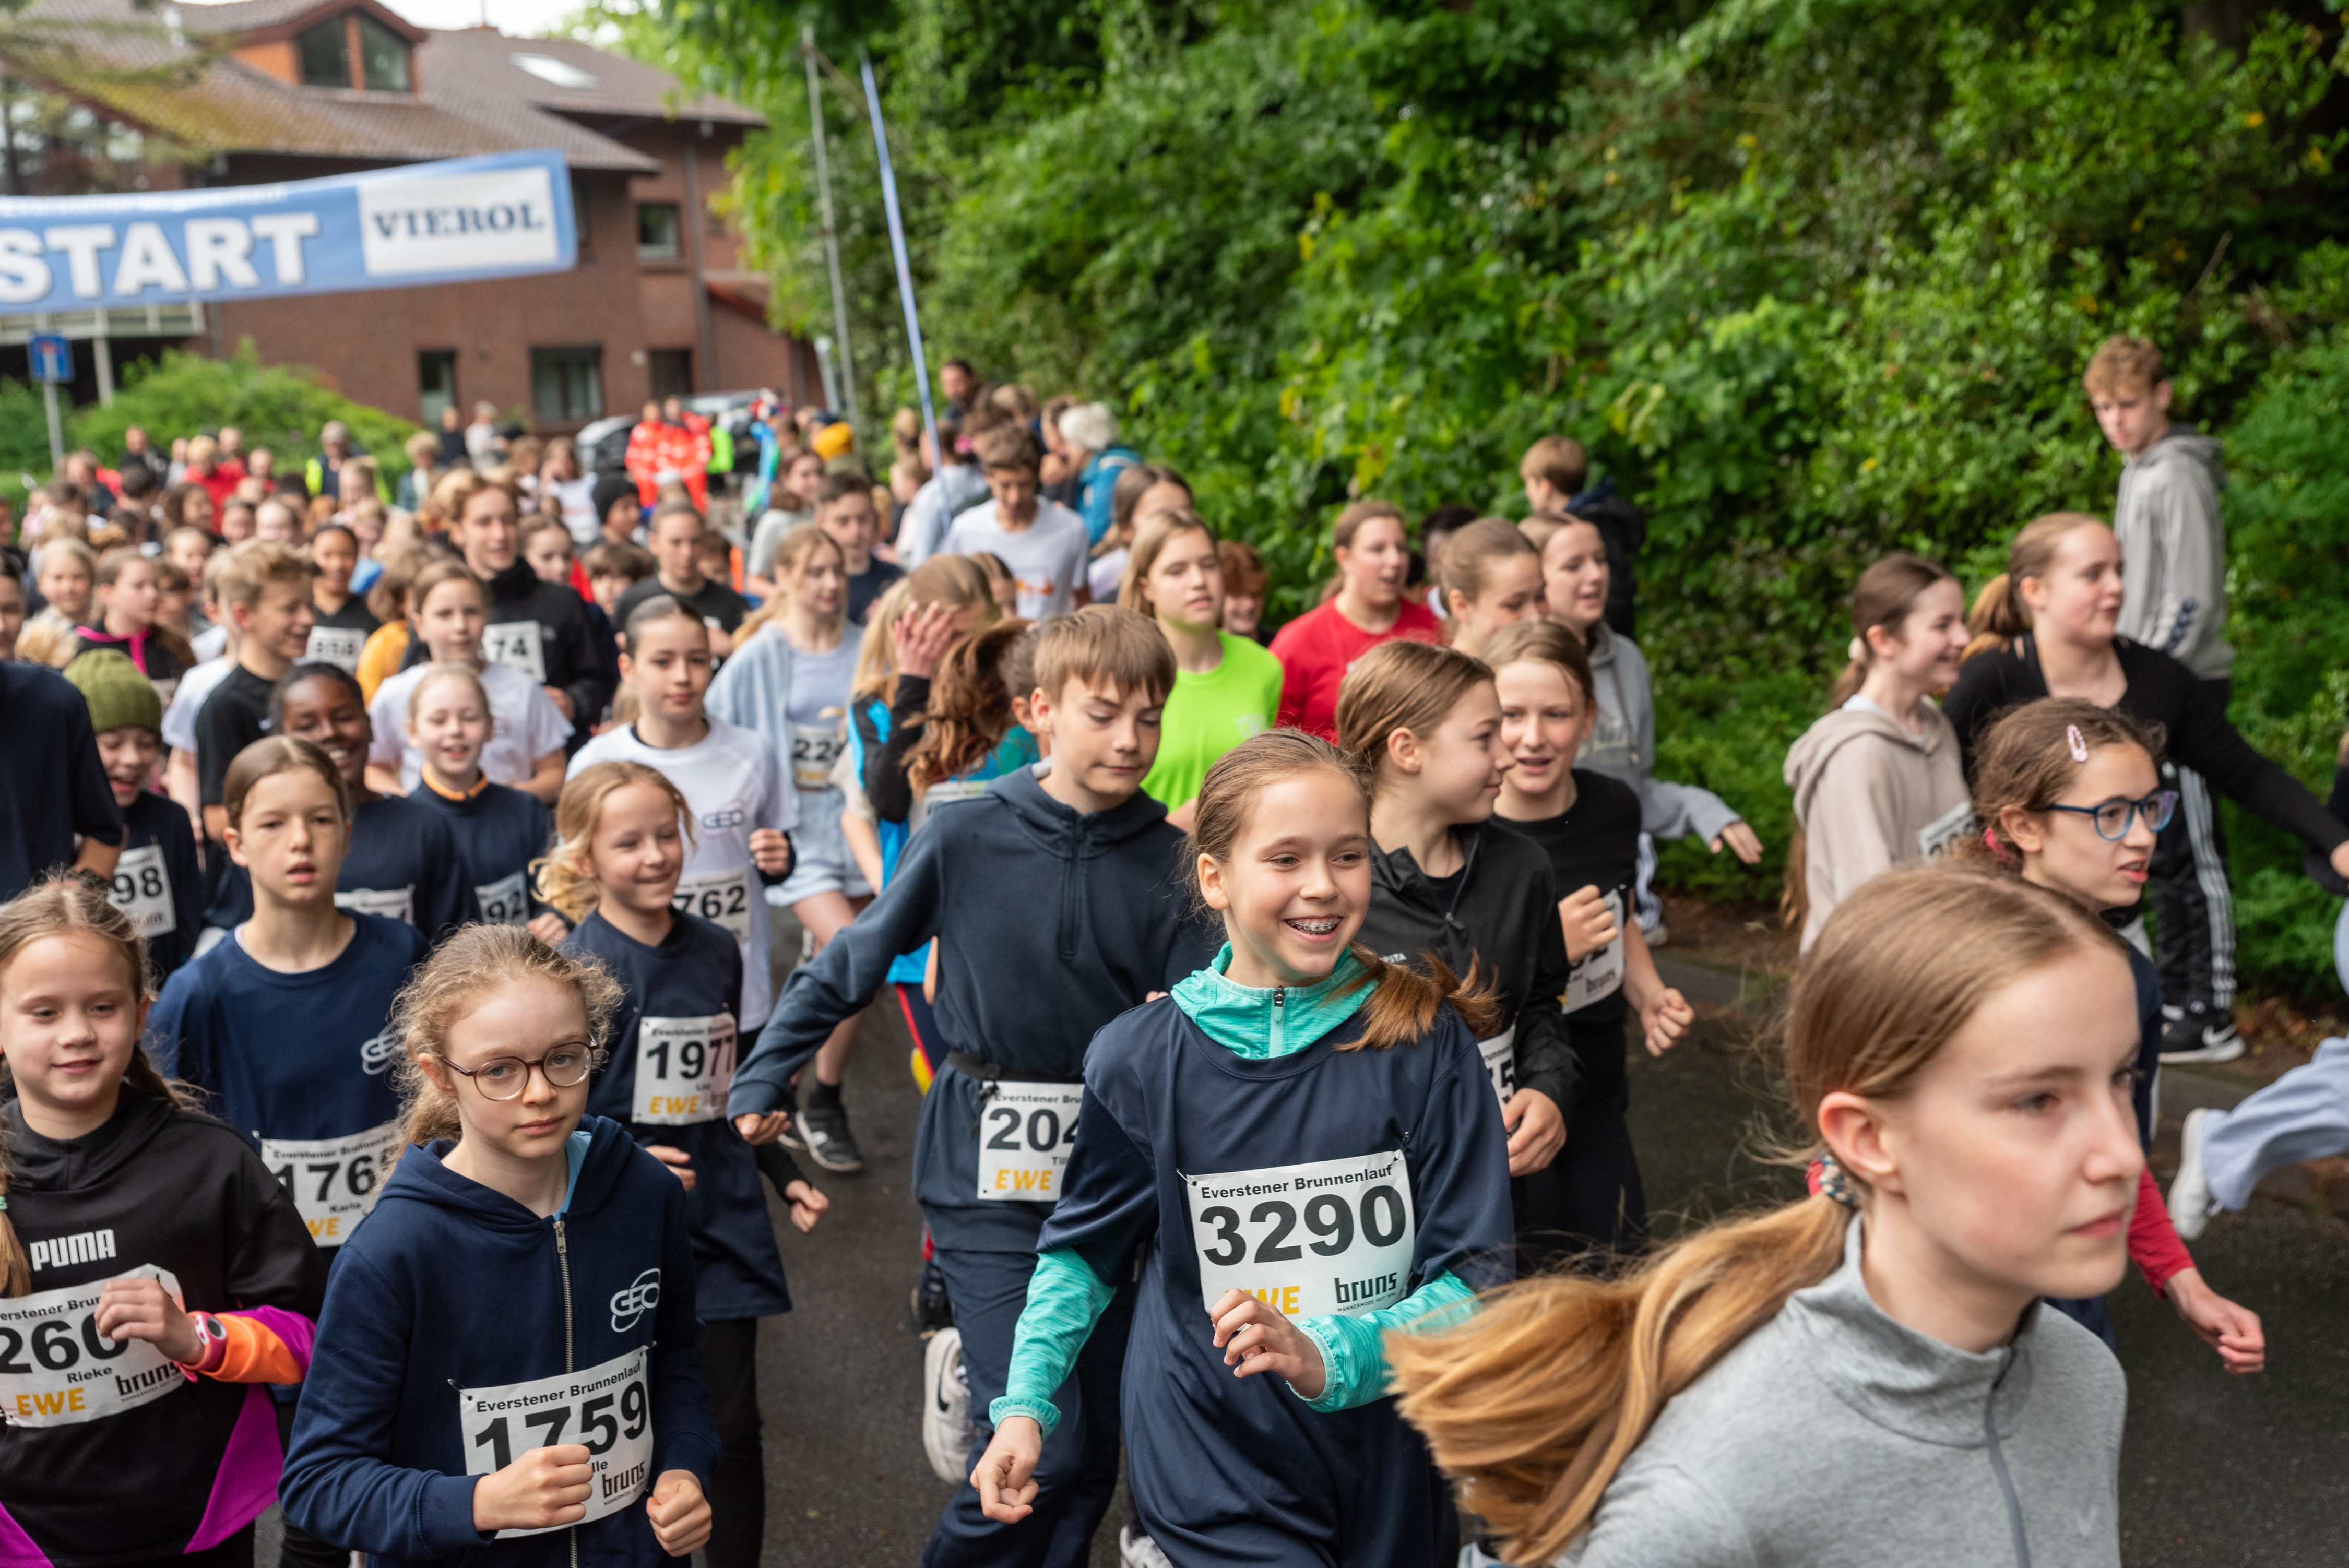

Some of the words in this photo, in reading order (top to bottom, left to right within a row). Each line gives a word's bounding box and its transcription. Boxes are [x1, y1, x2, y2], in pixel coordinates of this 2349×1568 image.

[372, 201, 545, 240] VIEROL
[0, 212, 319, 303] START
[646, 1035, 733, 1080] 1977
[649, 1095, 700, 1115] EWE
[995, 1169, 1053, 1191] EWE
[1201, 1180, 1289, 1199] Everstener
[1294, 1164, 1392, 1190] Brunnenlauf
[306, 1217, 340, 1238] WE
[1199, 1185, 1407, 1267] 3290
[29, 1228, 117, 1272] PUMA
[609, 1282, 660, 1317] GEO
[1225, 1285, 1300, 1315] WE
[1334, 1272, 1397, 1304] bruns
[66, 1366, 113, 1384] Rieke
[115, 1361, 180, 1396] bruns
[477, 1389, 565, 1412] Everstener
[570, 1361, 641, 1397] Brunnenlauf
[15, 1387, 86, 1416] EWE
[475, 1380, 646, 1475] 1759
[592, 1460, 608, 1473] lle
[601, 1460, 645, 1499] bruns
